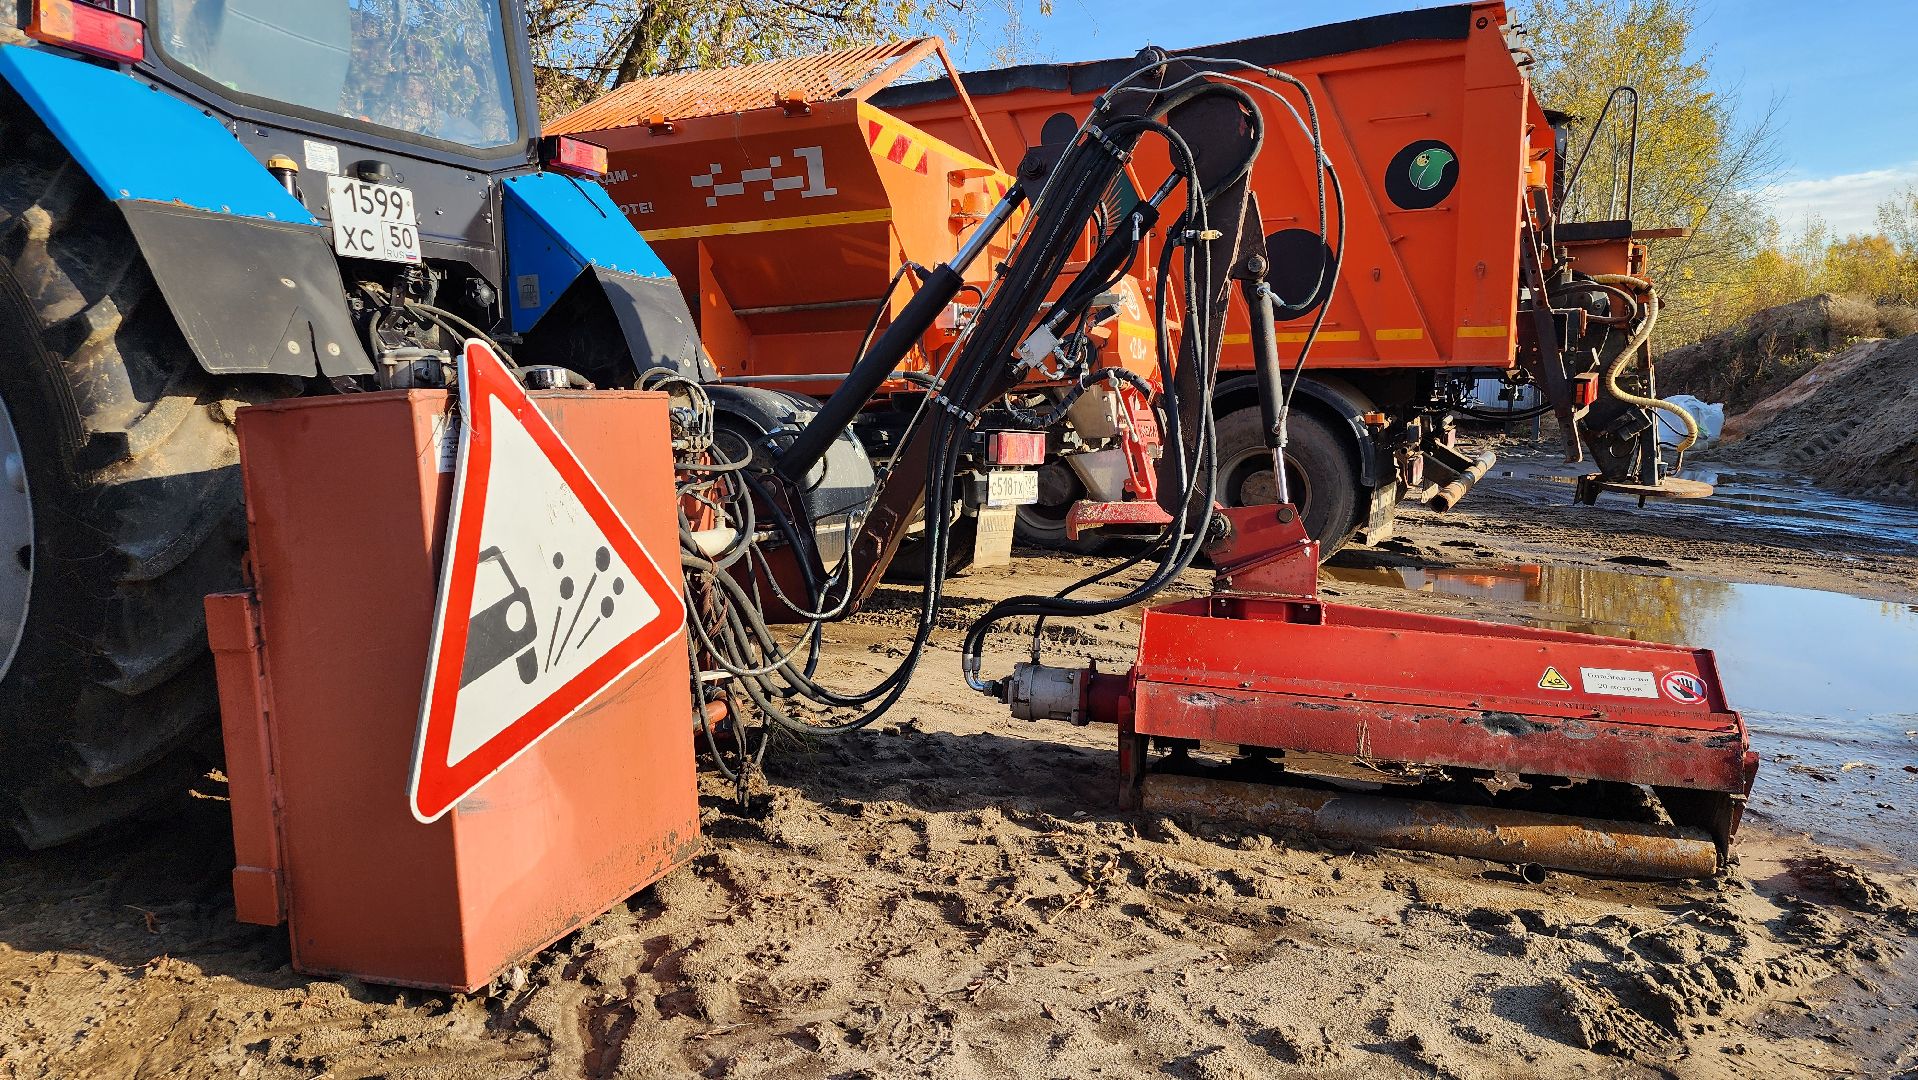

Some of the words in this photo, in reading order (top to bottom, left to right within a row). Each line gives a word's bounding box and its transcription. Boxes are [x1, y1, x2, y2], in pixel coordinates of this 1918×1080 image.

[343, 182, 404, 220] 1599
[342, 225, 375, 252] ХС
[389, 225, 413, 249] 50
[386, 249, 405, 259] RUS
